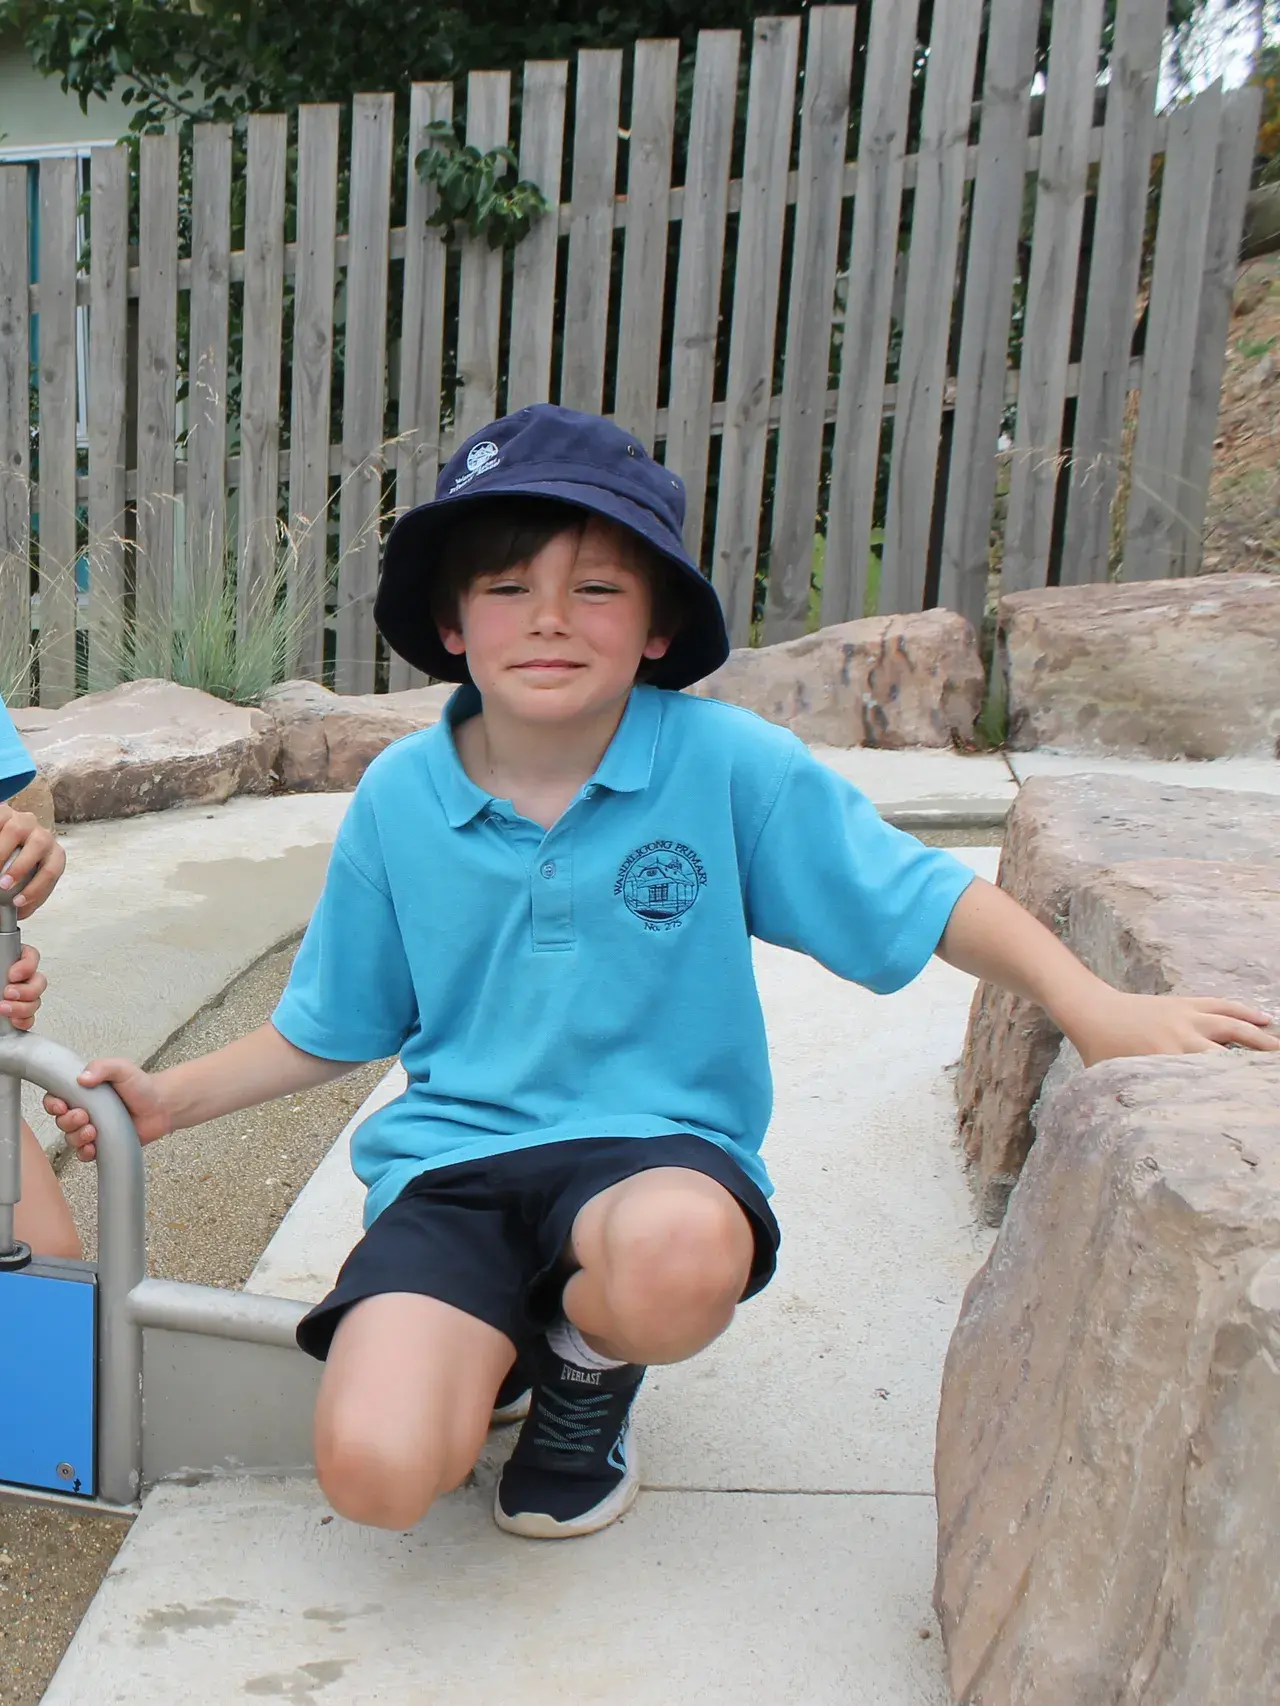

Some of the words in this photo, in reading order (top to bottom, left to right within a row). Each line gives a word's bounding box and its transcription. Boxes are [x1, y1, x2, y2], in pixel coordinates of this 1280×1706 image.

[614, 840, 673, 896] WANDILIGONG
[674, 843, 708, 887] PRIMARY
[560, 1364, 602, 1386] EVERLAST
